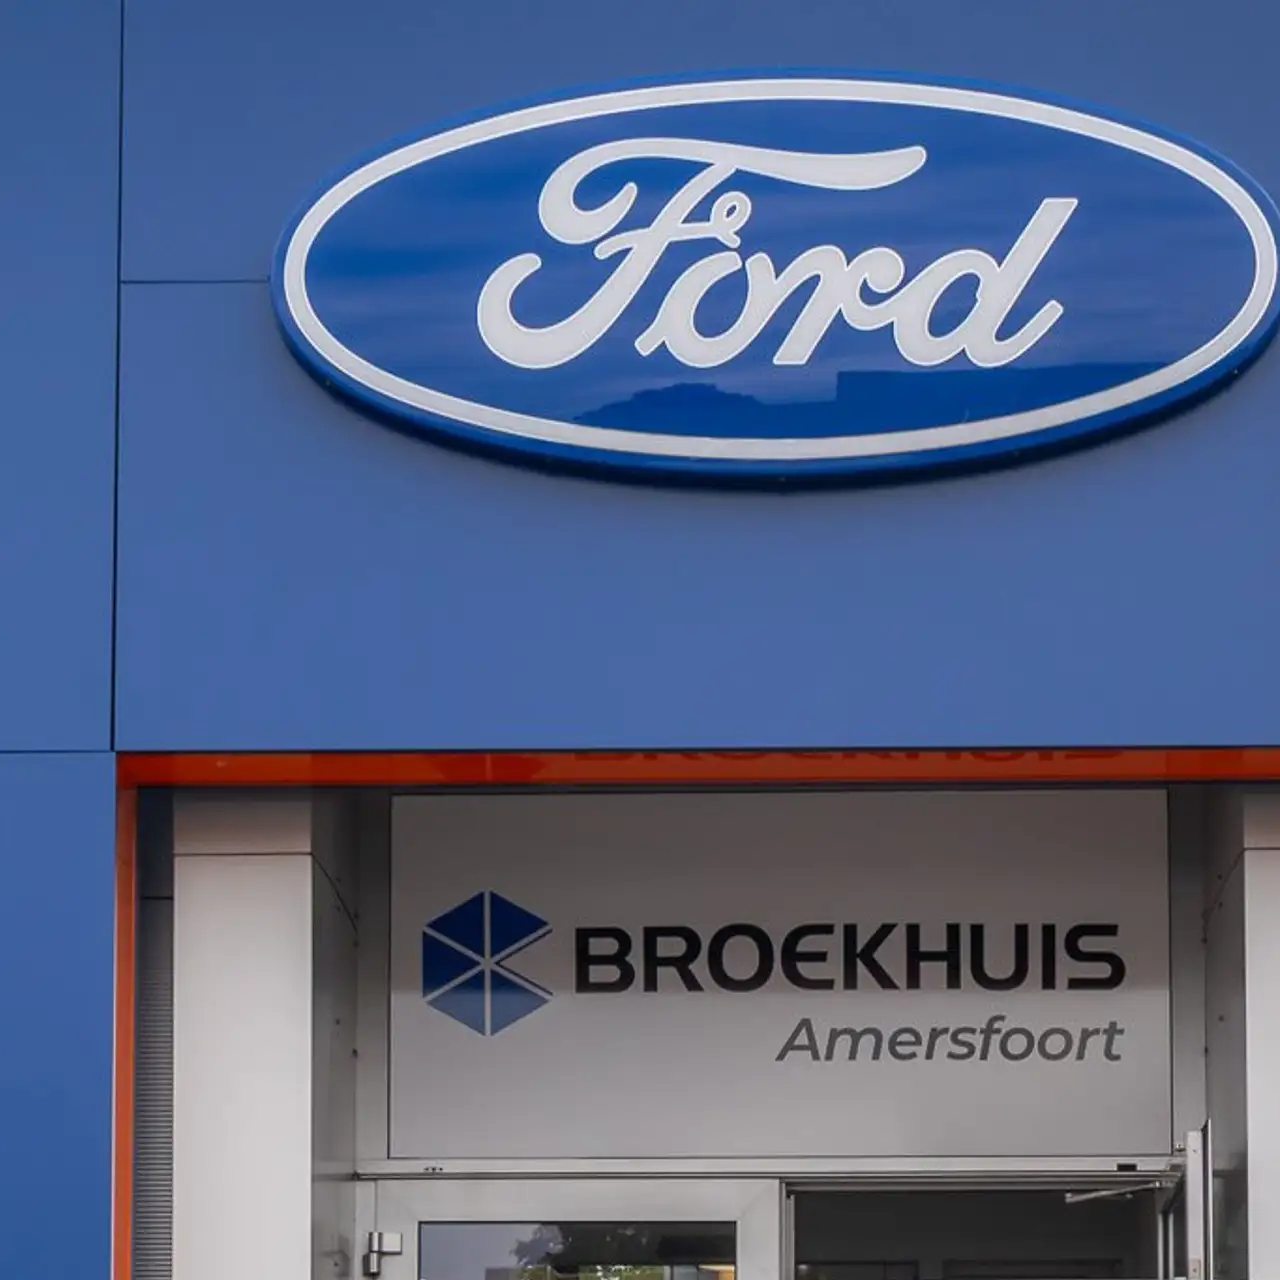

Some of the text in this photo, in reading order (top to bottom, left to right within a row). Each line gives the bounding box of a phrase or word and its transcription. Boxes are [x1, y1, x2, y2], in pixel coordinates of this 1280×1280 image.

[477, 138, 1079, 369] Ford
[575, 922, 1126, 993] BROEKHUIS
[775, 1015, 1125, 1062] Amersfoort
